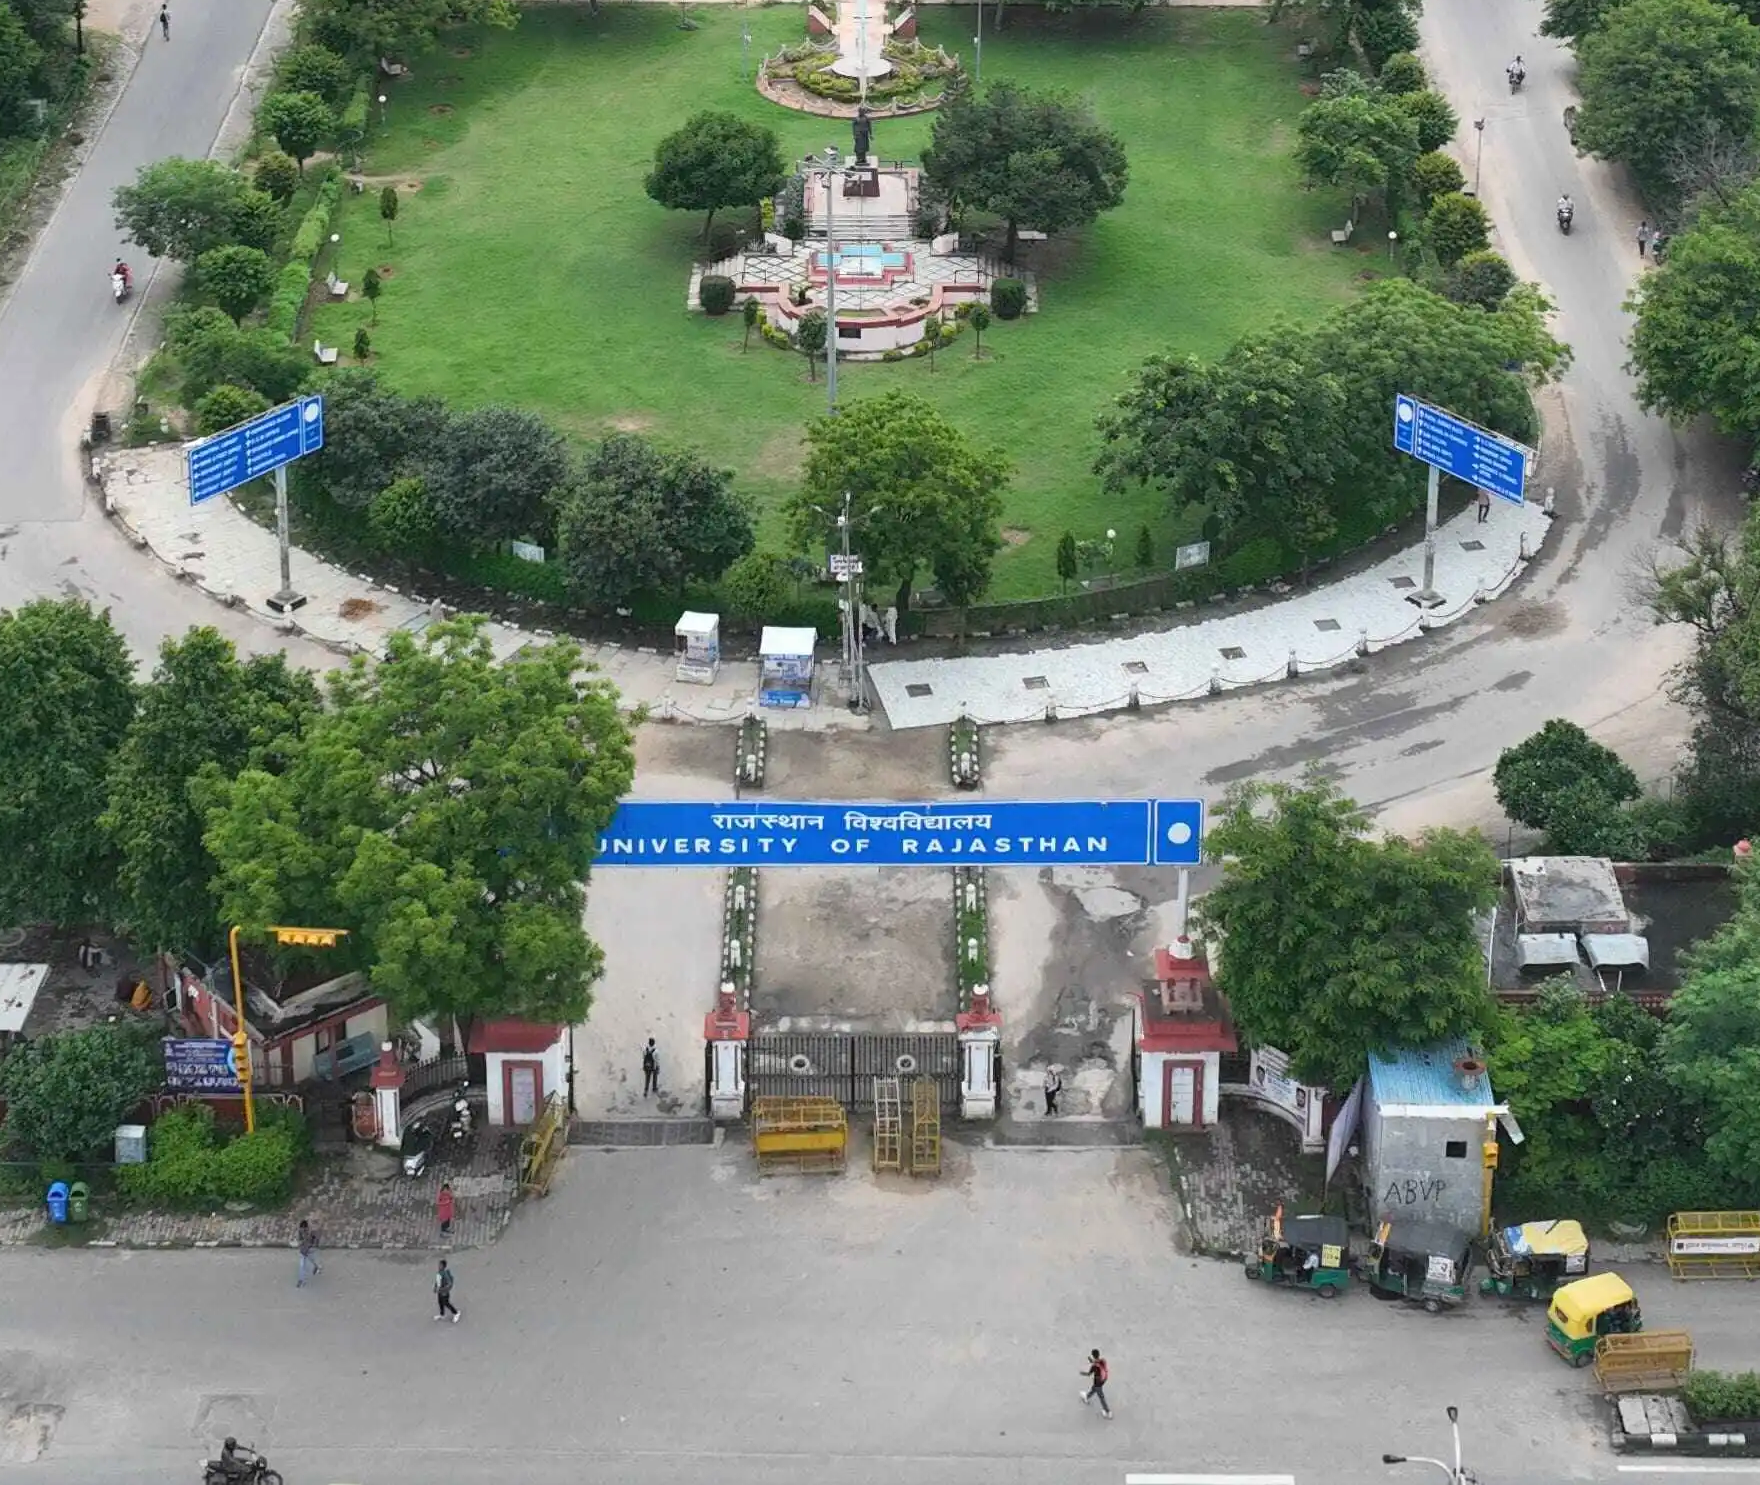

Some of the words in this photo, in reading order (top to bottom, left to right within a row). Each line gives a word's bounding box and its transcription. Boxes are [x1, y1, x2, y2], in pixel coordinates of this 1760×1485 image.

[712, 813, 824, 831] राजस्थान
[844, 810, 992, 831] विश्वविद्यालय
[830, 838, 870, 853] OF
[902, 836, 1108, 853] RAJASTHAN
[1383, 1179, 1447, 1205] ABVP
